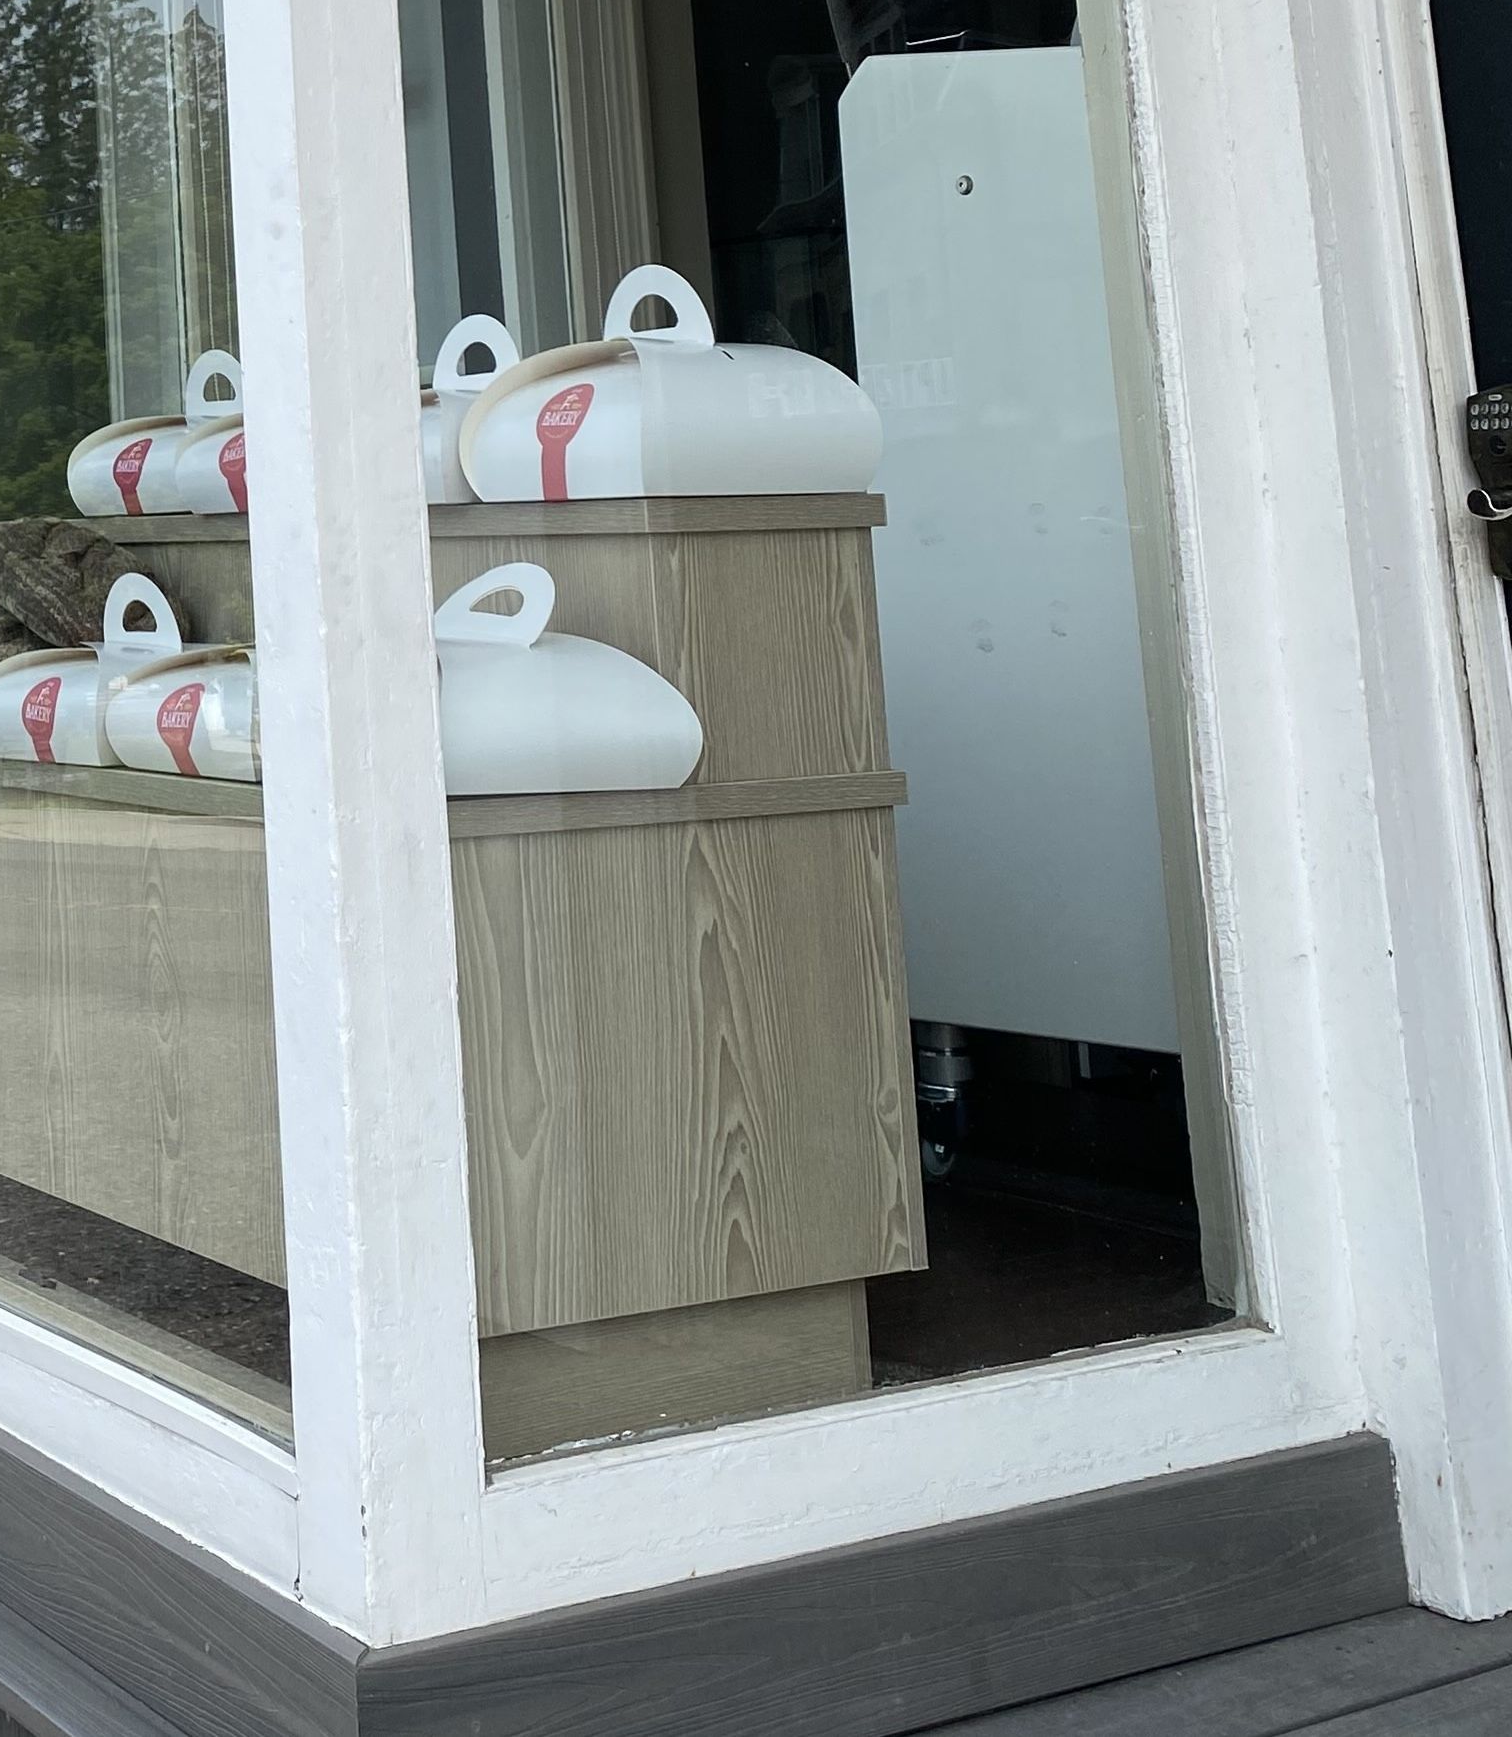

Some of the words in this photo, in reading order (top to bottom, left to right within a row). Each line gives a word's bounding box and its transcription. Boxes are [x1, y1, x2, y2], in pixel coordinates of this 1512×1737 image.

[541, 410, 582, 426] BAKERY
[25, 703, 53, 723] BAKERY
[160, 711, 193, 728] BAKERY
